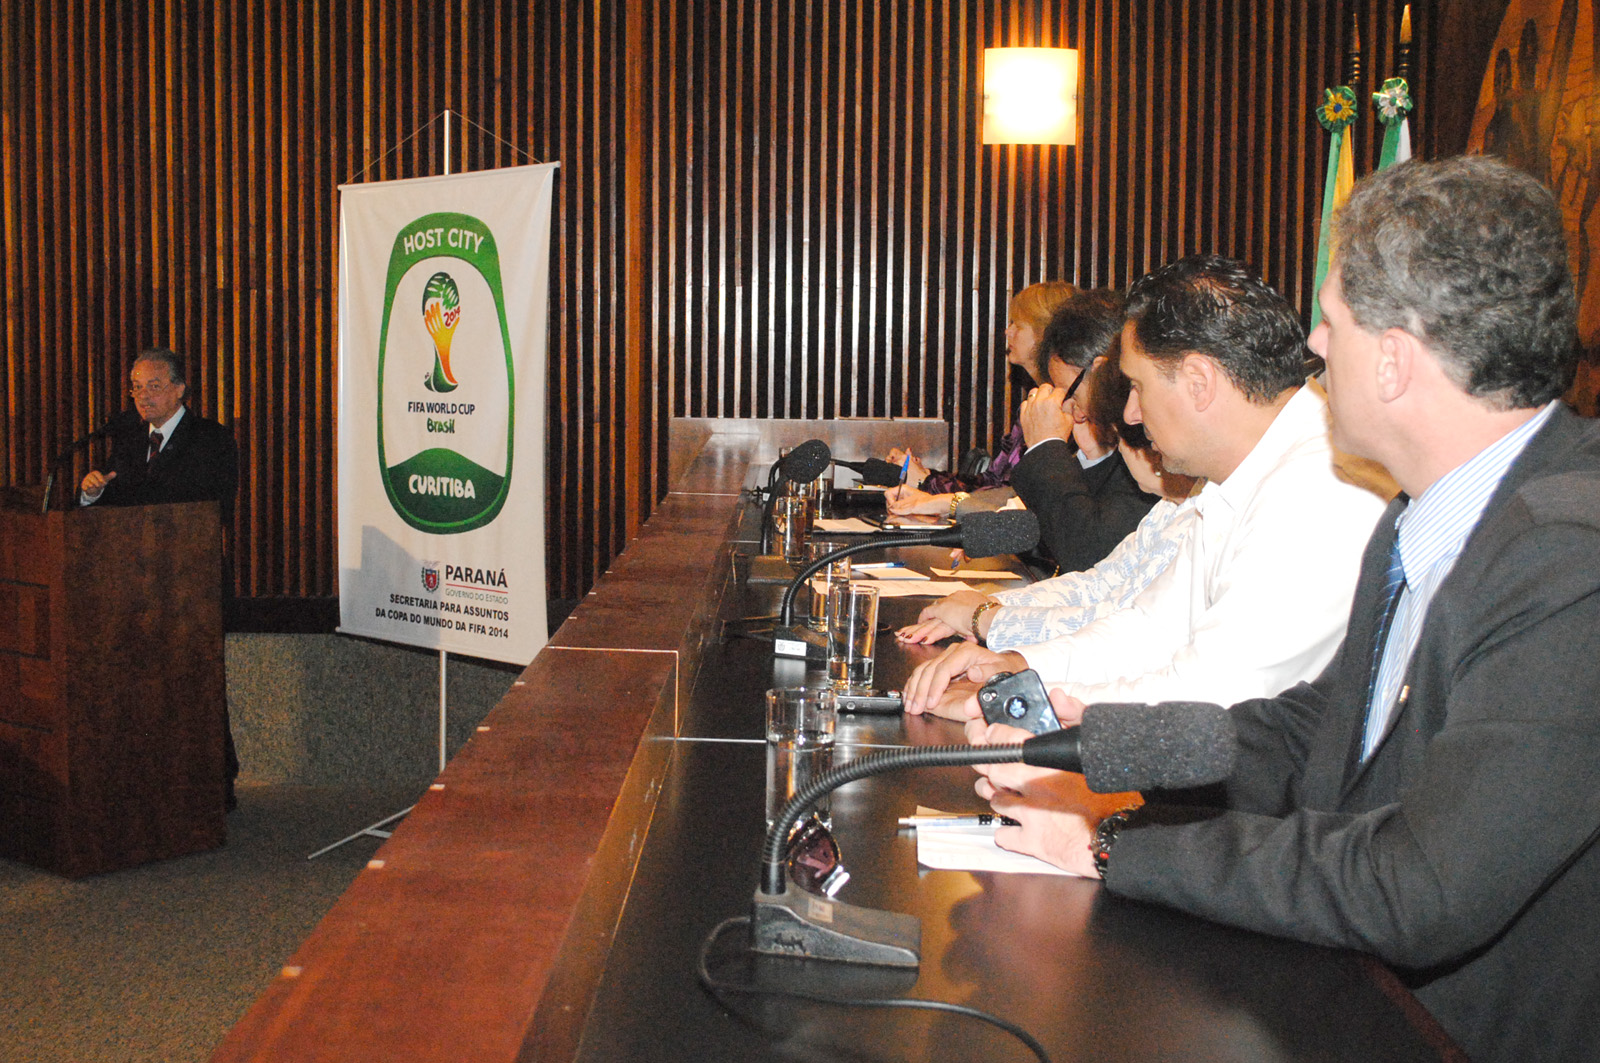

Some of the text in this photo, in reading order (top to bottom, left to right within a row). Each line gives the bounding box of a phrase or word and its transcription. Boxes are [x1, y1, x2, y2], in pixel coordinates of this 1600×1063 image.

[404, 228, 484, 255] HOST CITY
[444, 306, 460, 327] 2014
[408, 401, 476, 415] FIFA WORLD CUP
[426, 417, 455, 434] Brasil
[408, 474, 476, 499] CURITIBA
[445, 564, 508, 588] PARANÁ
[390, 593, 509, 621] SECRETARIA PARA ASSUNTOS
[445, 588, 509, 605] GOVERNO DO ESTADO
[375, 607, 509, 639] DA COPA DO MUNDO DA FIFA 2014
